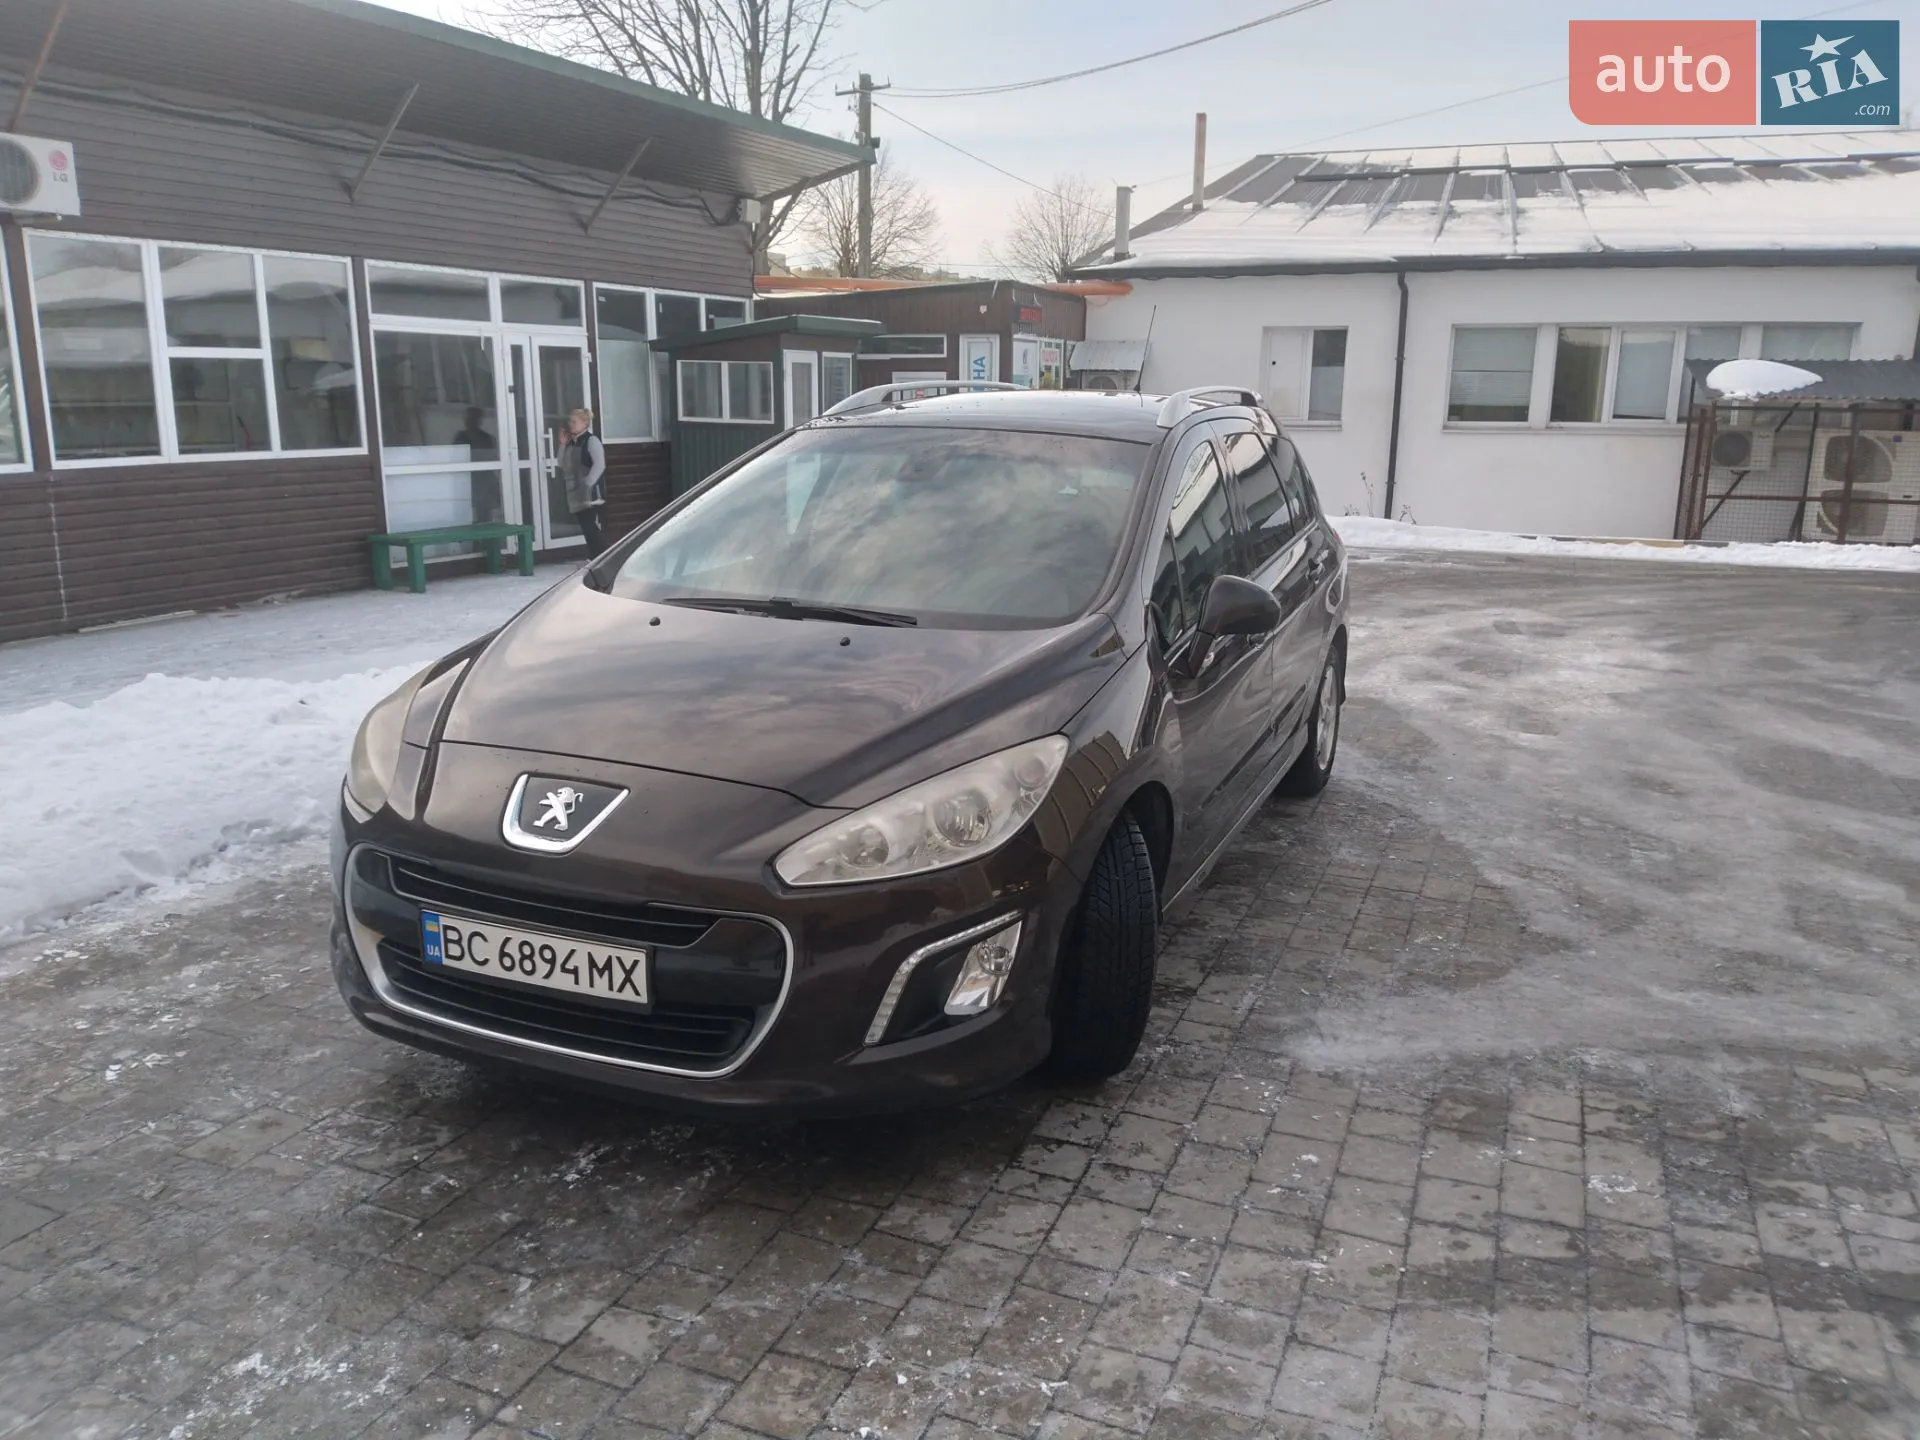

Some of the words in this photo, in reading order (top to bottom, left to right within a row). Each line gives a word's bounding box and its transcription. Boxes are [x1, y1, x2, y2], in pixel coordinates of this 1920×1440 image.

[53, 172, 68, 182] LG
[973, 356, 986, 391] НА
[427, 944, 440, 957] UA
[442, 924, 490, 966] BC
[498, 936, 580, 986] 6894
[587, 950, 641, 997] MX
